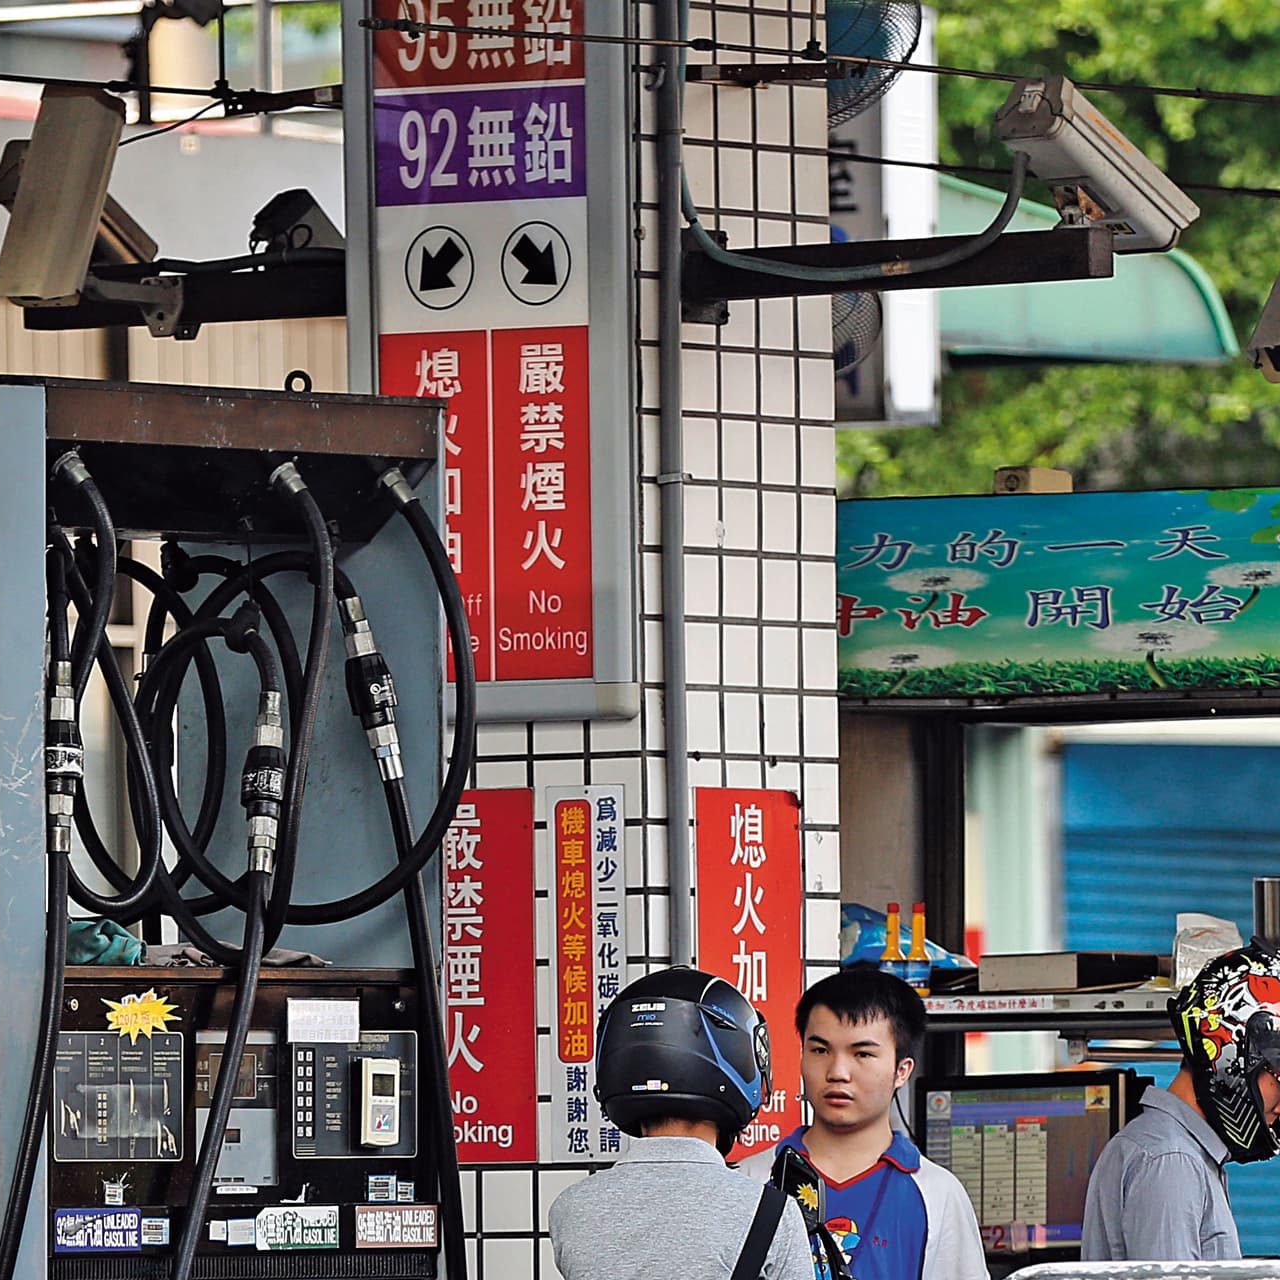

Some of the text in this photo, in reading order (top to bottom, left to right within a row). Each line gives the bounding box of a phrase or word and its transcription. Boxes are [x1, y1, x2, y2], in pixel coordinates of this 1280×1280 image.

[399, 102, 572, 189] 92無鉛
[518, 343, 566, 571] 嚴禁煙火
[528, 590, 562, 614] No
[498, 627, 588, 656] Smoking
[730, 803, 768, 1004] 熄火加
[560, 807, 588, 1058] 機車熄火等候加油
[566, 1066, 590, 1154] 謝謝您
[103, 1212, 138, 1230] UNLEADED
[402, 1209, 435, 1226] UNLEADED
[103, 1231, 138, 1248] GASOLINE
[303, 1228, 337, 1245] GASOLINE
[402, 1226, 435, 1243] GASOLINE
